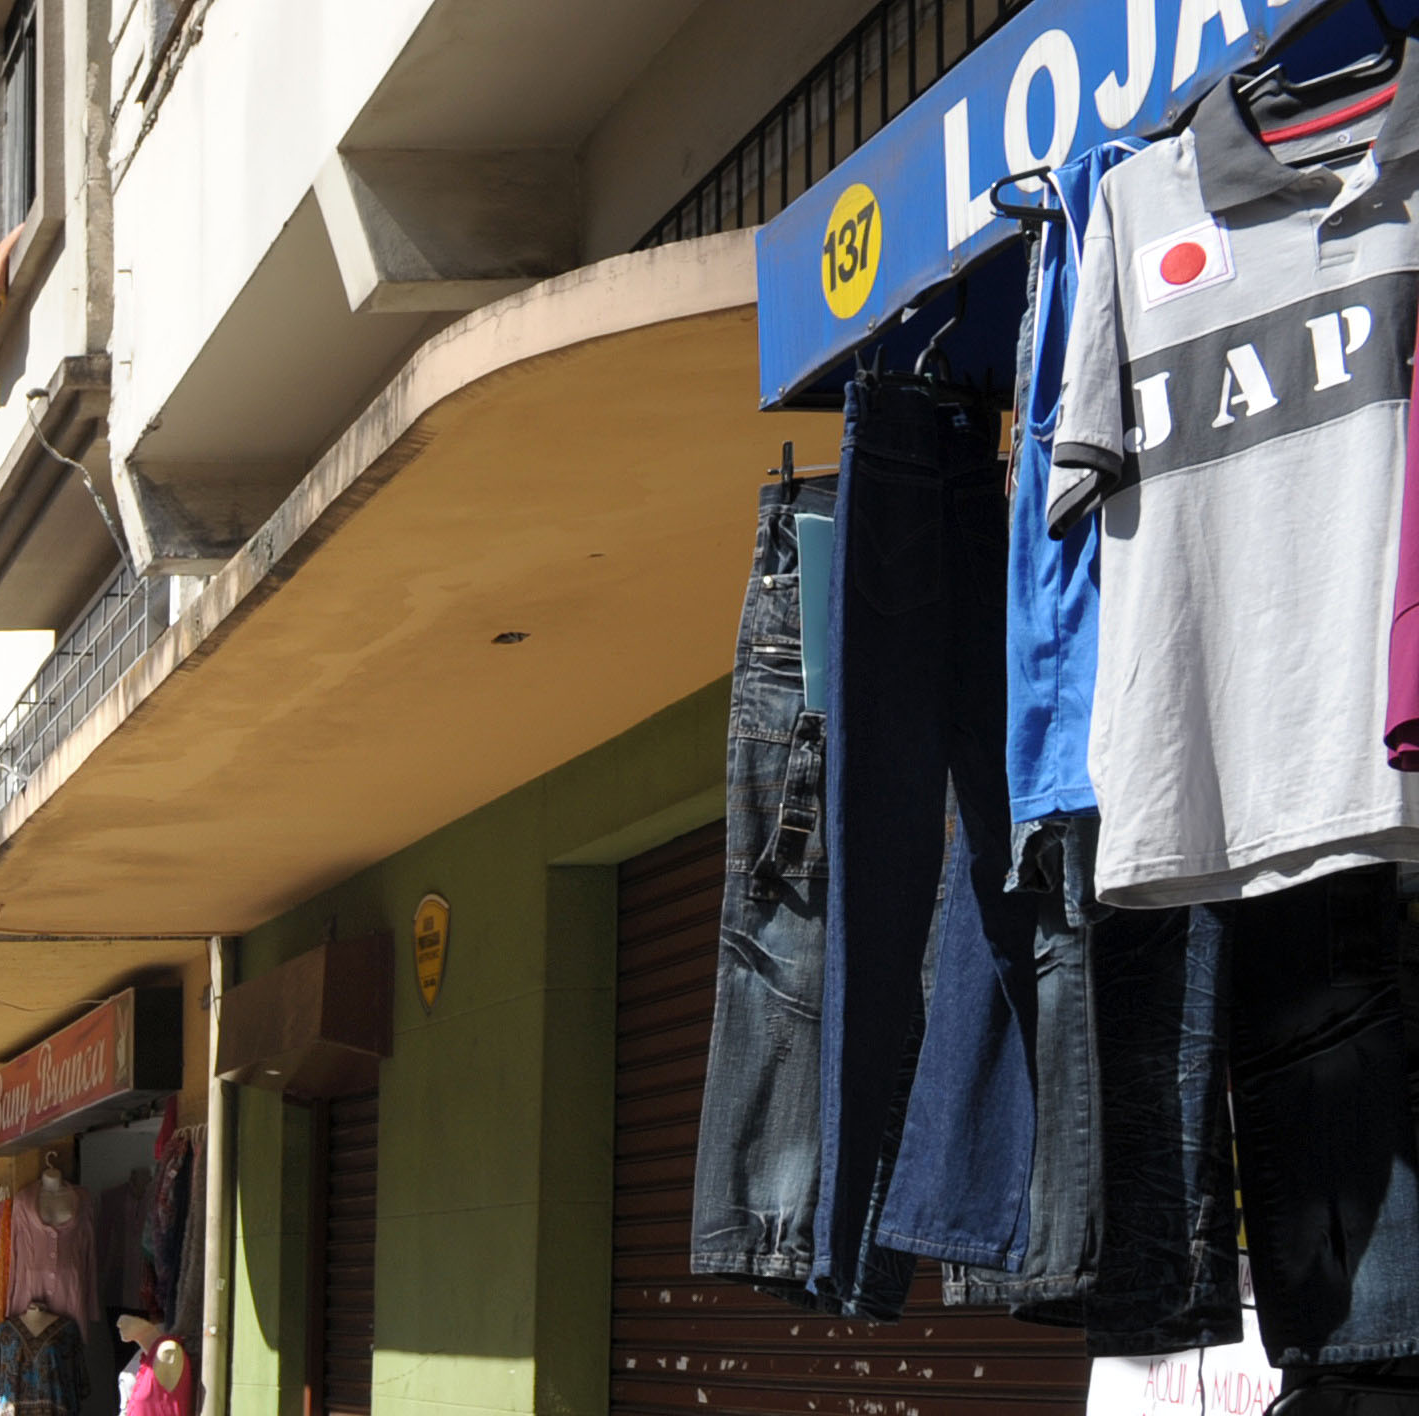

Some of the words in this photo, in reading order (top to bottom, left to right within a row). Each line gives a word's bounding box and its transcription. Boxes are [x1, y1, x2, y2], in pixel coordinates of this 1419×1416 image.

[823, 200, 875, 292] 137
[1124, 305, 1414, 453] JAP
[35, 1038, 107, 1115] Branca
[1144, 1359, 1187, 1404] AQUI
